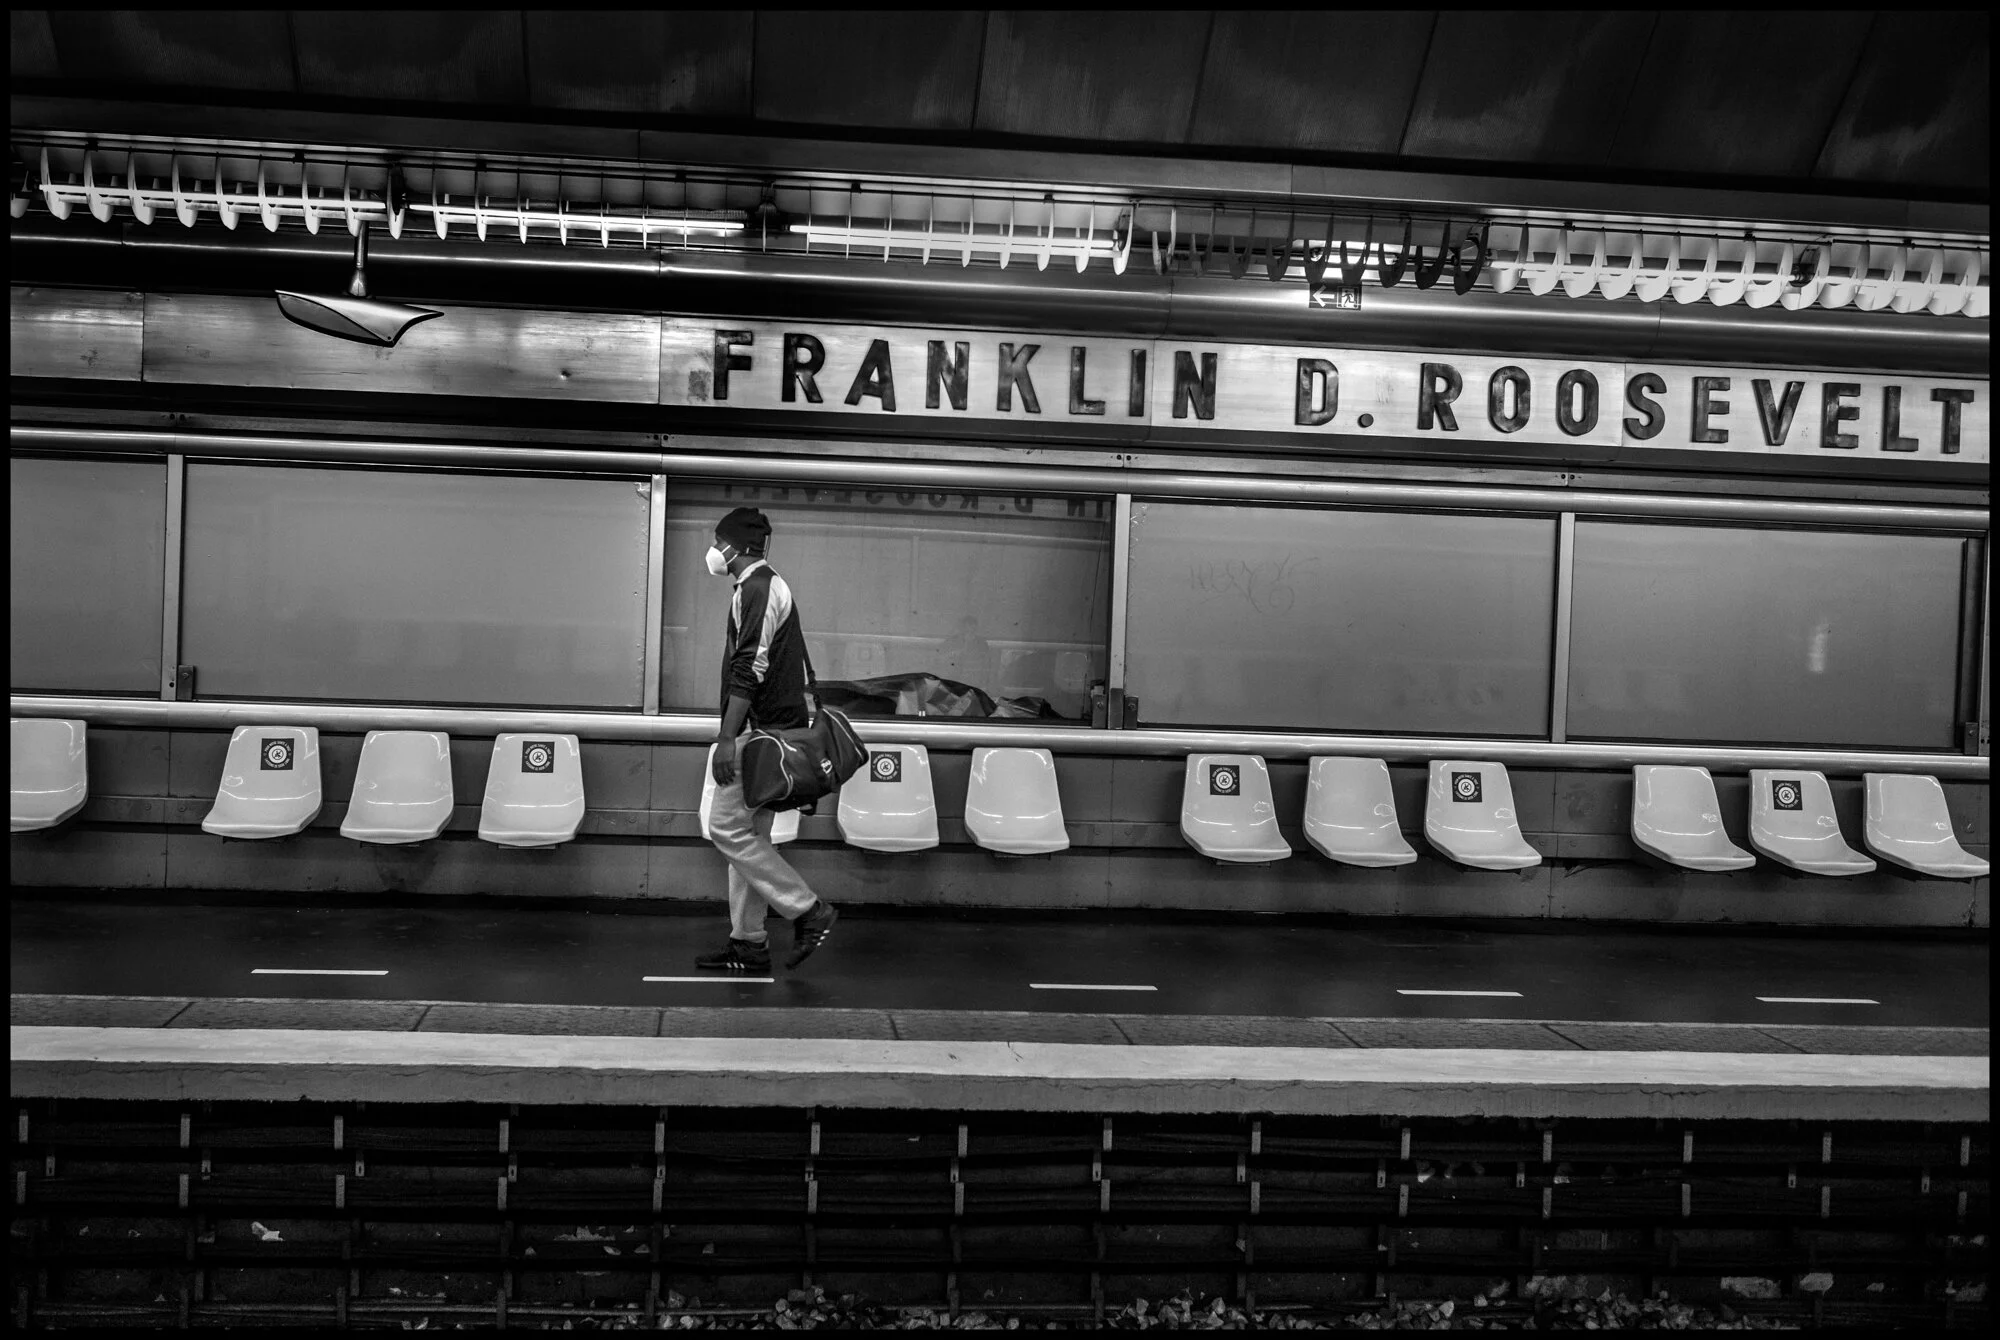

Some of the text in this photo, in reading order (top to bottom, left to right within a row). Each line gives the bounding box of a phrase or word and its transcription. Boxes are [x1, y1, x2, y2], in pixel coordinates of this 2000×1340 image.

[713, 329, 1976, 455] FRANKLIN D. ROOSEVELT
